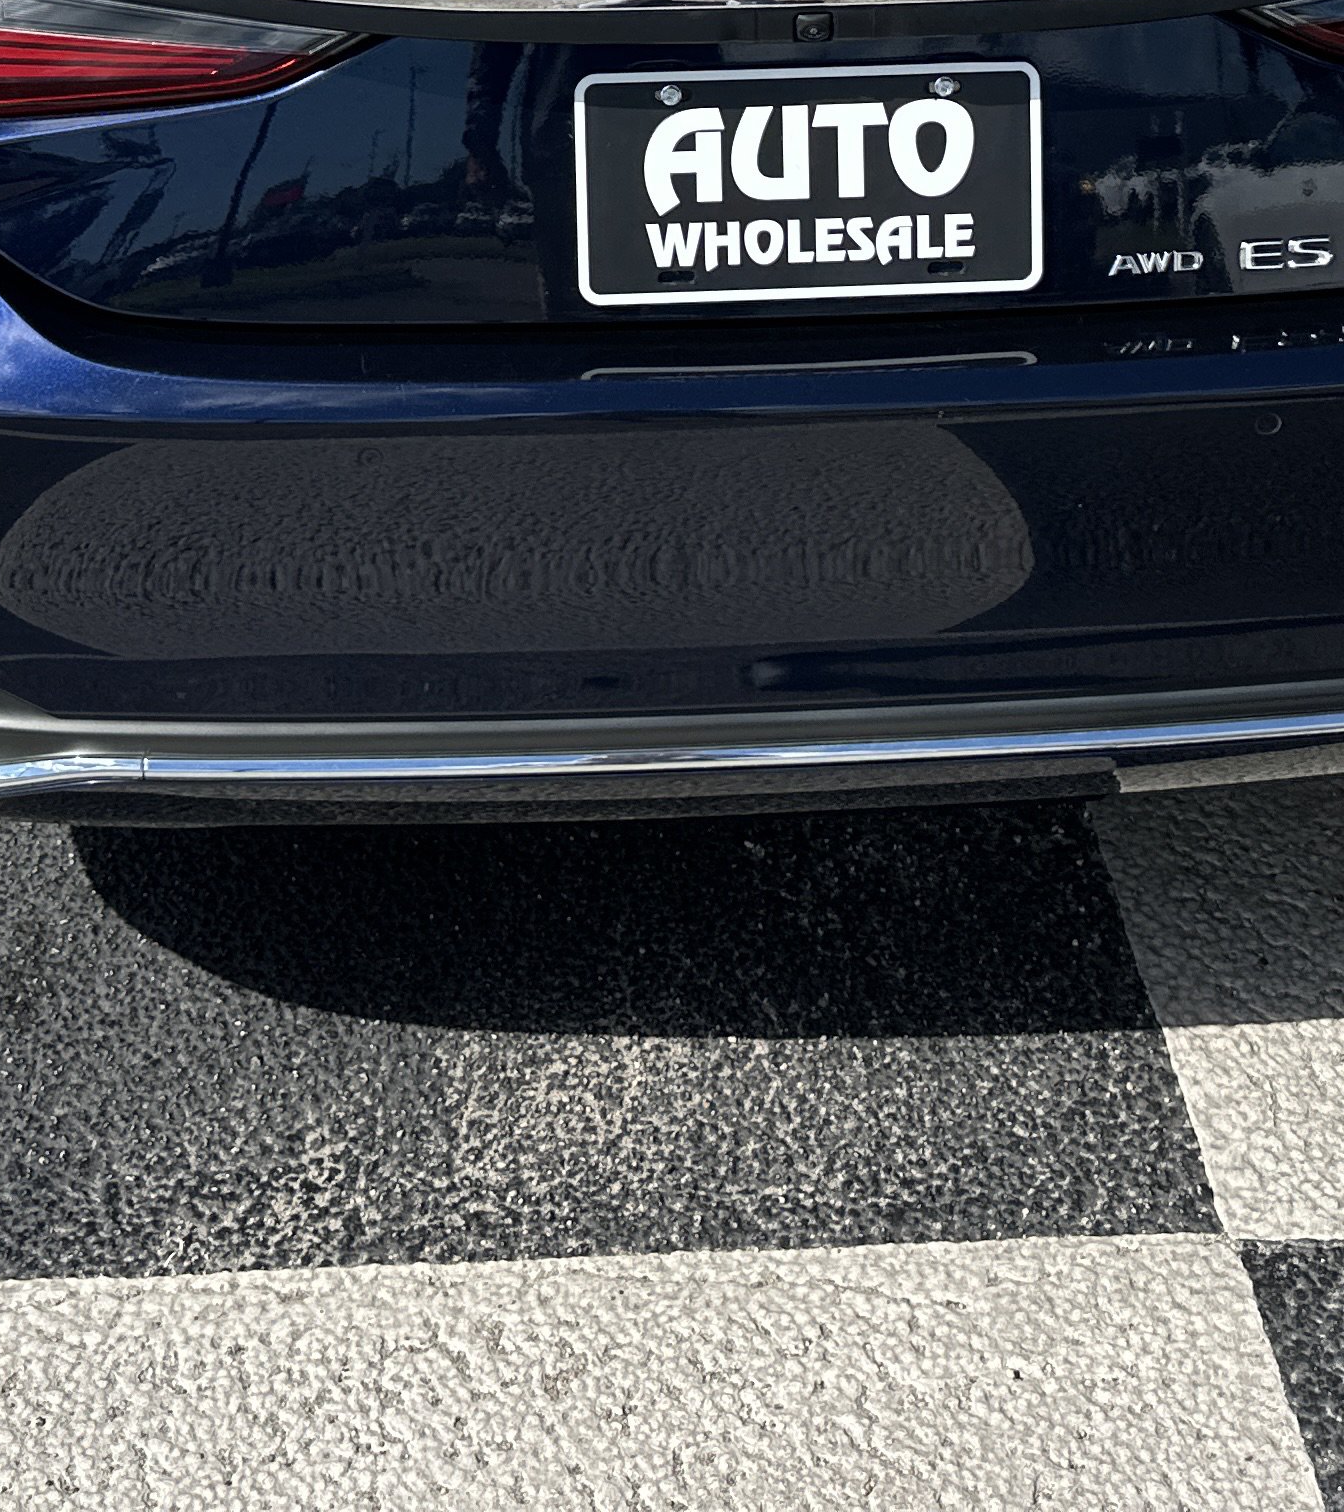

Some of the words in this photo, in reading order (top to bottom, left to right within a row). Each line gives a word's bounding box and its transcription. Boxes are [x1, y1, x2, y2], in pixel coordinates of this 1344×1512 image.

[643, 98, 975, 217] AUTO
[645, 213, 976, 272] WHOLESALE
[1108, 250, 1204, 277] AWD
[1239, 237, 1334, 271] ES
